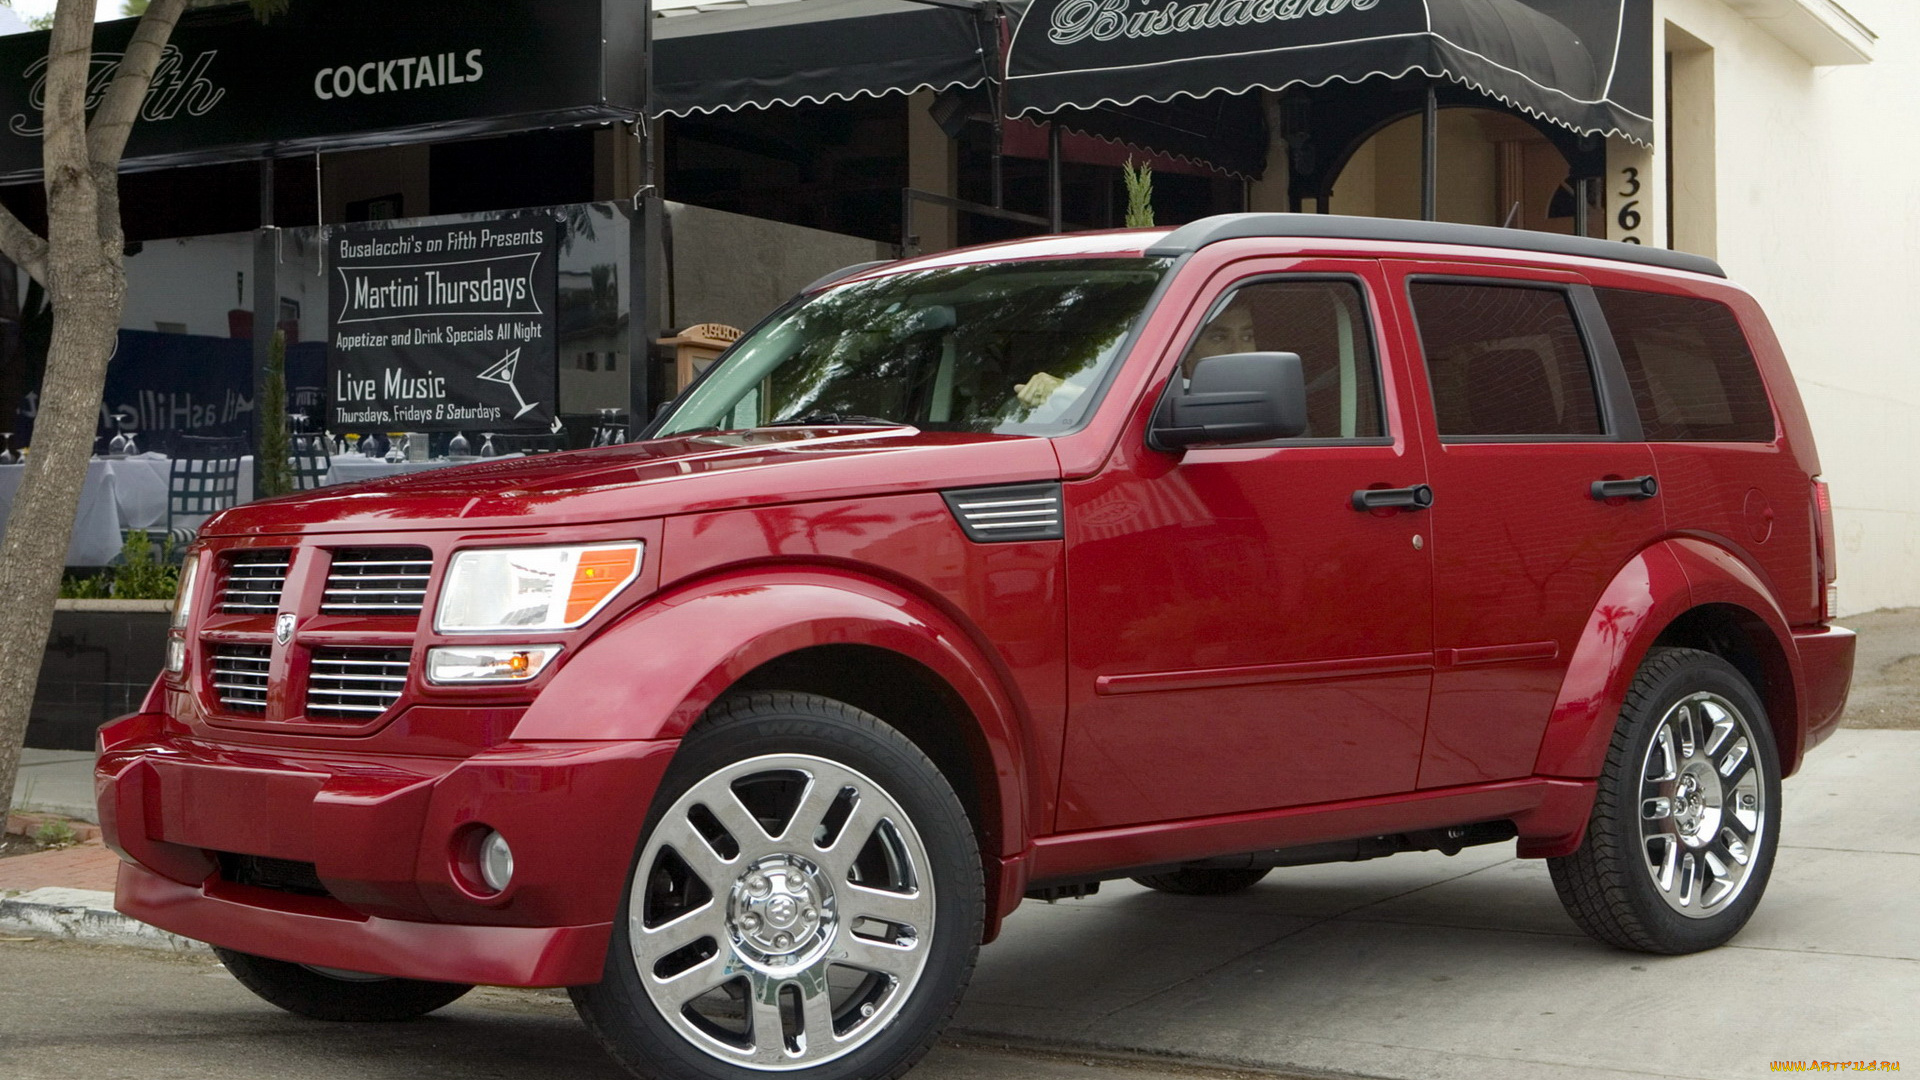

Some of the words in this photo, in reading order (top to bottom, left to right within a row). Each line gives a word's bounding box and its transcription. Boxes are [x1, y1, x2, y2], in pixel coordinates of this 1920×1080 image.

[1048, 0, 1379, 45] Busalacc
[314, 48, 483, 101] COCKTAILS
[1618, 166, 1641, 245] 36
[340, 235, 422, 258] Busalacchi's
[427, 240, 442, 251] on
[448, 232, 476, 250] Fifth
[481, 229, 543, 248] Presents
[354, 276, 418, 309] Martini
[425, 267, 525, 308] Thursdays
[336, 332, 388, 351] Appetizer
[391, 329, 411, 345] and
[415, 327, 443, 345] Drink
[447, 325, 493, 345] Specials
[497, 323, 510, 340] All
[514, 322, 542, 342] Night
[338, 370, 376, 401] Live
[384, 368, 445, 399] Music
[337, 407, 391, 425] Thursdays,
[394, 405, 432, 423] Fridays
[436, 404, 443, 420] &
[447, 403, 501, 421] Saturdays
